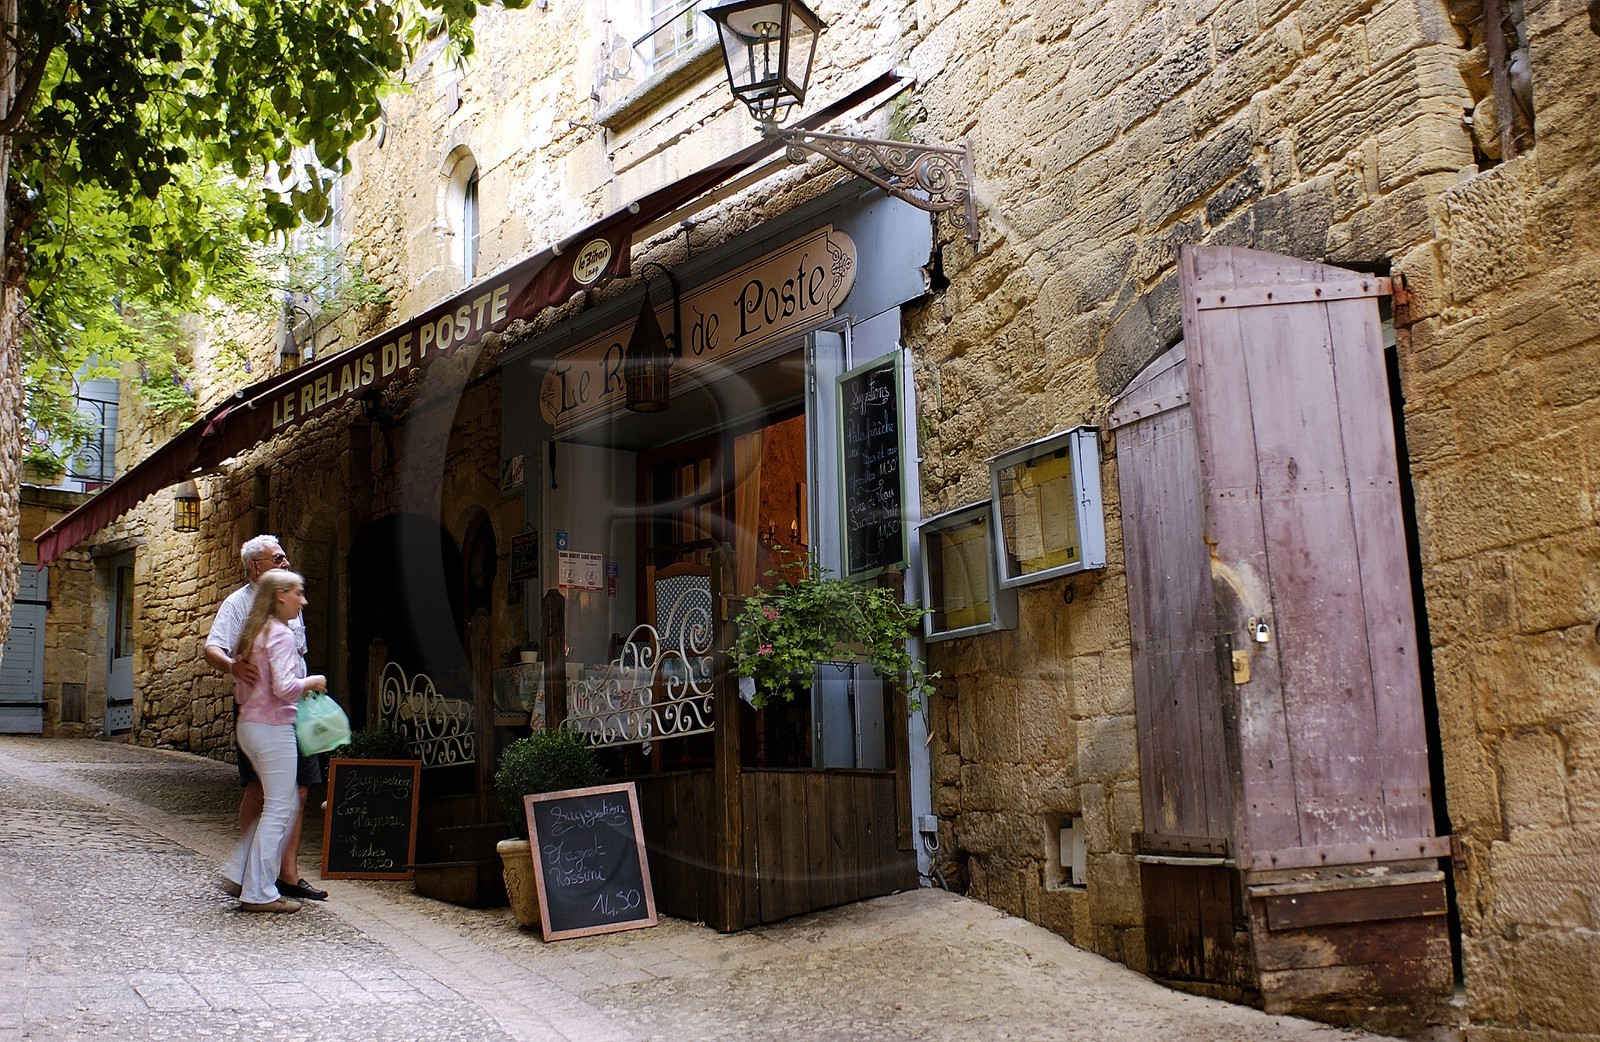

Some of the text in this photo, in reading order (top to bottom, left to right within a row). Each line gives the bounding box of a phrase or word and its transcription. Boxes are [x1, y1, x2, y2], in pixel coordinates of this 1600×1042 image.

[555, 364, 592, 414] Le
[691, 304, 720, 357] de
[734, 252, 826, 343] Poste
[272, 283, 511, 430] LE RELAIS DE POSTE
[344, 770, 412, 796] Suggestion
[550, 798, 626, 829] Suggestion
[549, 865, 607, 888] Rossini
[591, 888, 642, 918] 14,50
